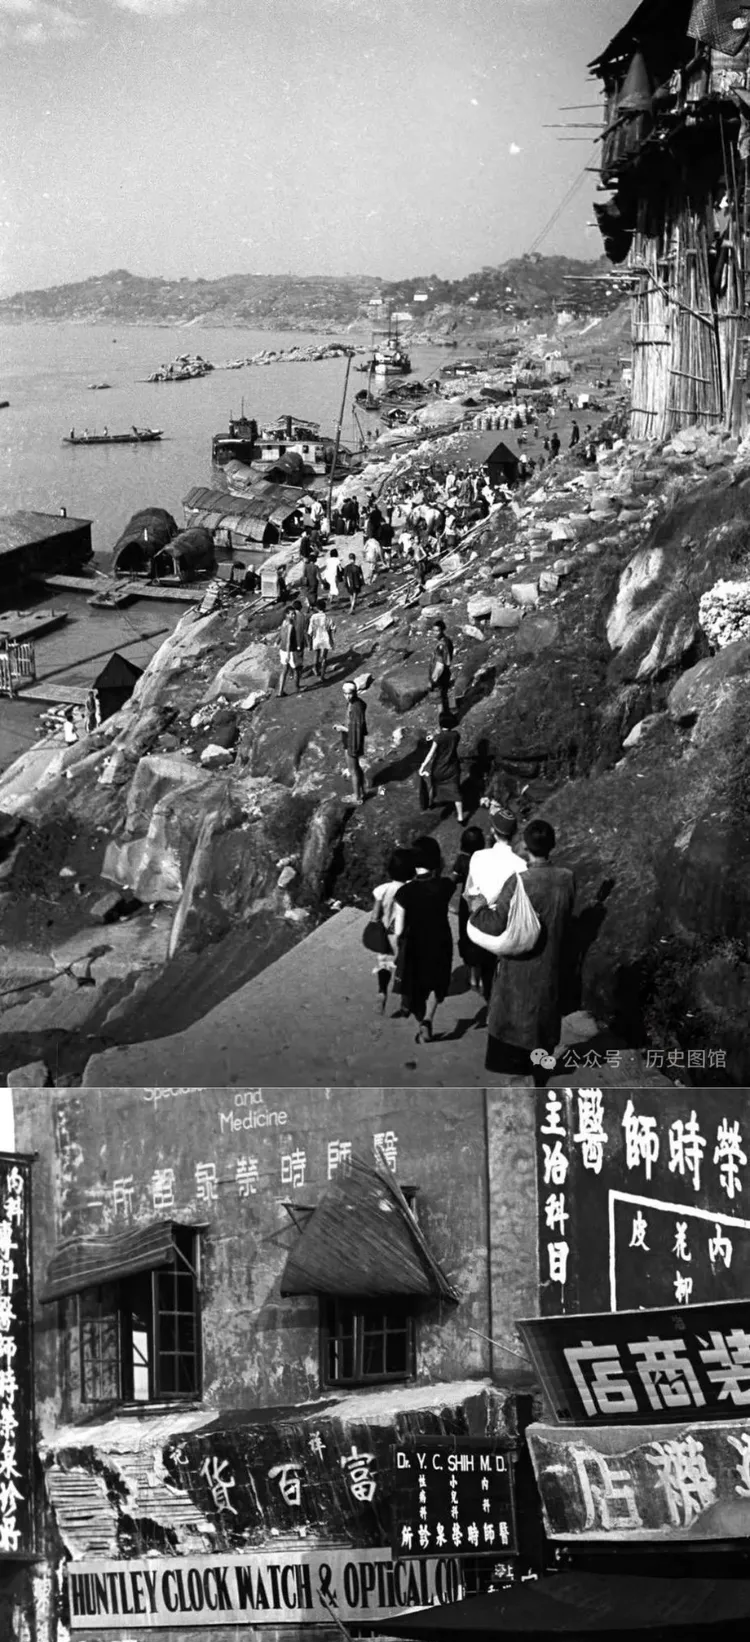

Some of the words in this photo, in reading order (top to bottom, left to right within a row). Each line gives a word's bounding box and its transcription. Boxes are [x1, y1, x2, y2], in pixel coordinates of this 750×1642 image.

[234, 1088, 263, 1107] and
[219, 1109, 288, 1133] Medicine
[540, 1089, 570, 1285] 主治科目
[628, 1210, 650, 1251] 皮
[672, 1221, 693, 1305] 花柳
[397, 1452, 411, 1469] Dr.
[416, 1453, 427, 1469] Y.
[432, 1454, 443, 1470] C.
[447, 1454, 474, 1471] SHIH
[480, 1455, 492, 1471] M.
[495, 1456, 507, 1472] D.
[70, 1570, 159, 1616] HUNTLEY
[162, 1566, 233, 1613] CLOCK
[234, 1564, 314, 1610] WATCH
[317, 1563, 339, 1608] &
